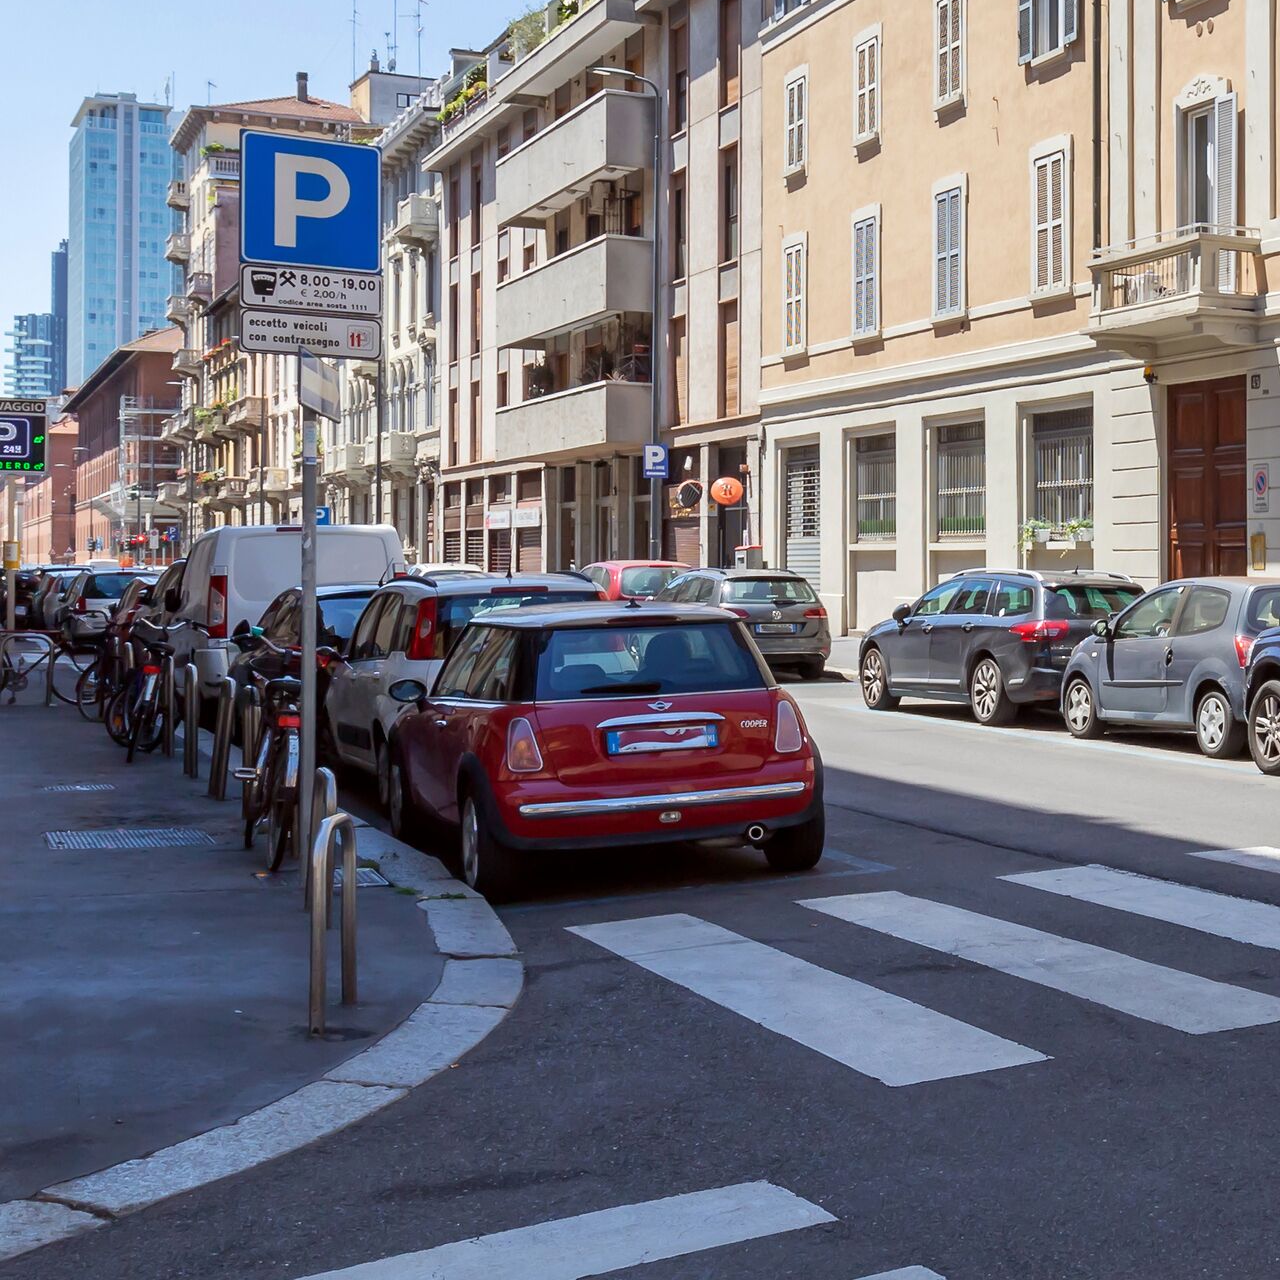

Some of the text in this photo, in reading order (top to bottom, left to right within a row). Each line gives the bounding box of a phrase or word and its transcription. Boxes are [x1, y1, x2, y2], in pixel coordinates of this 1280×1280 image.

[274, 152, 350, 248] P
[249, 318, 328, 332] eccetto veicoli
[249, 333, 340, 349] con contrassegno
[645, 445, 665, 470] P
[740, 719, 768, 728] COOPER
